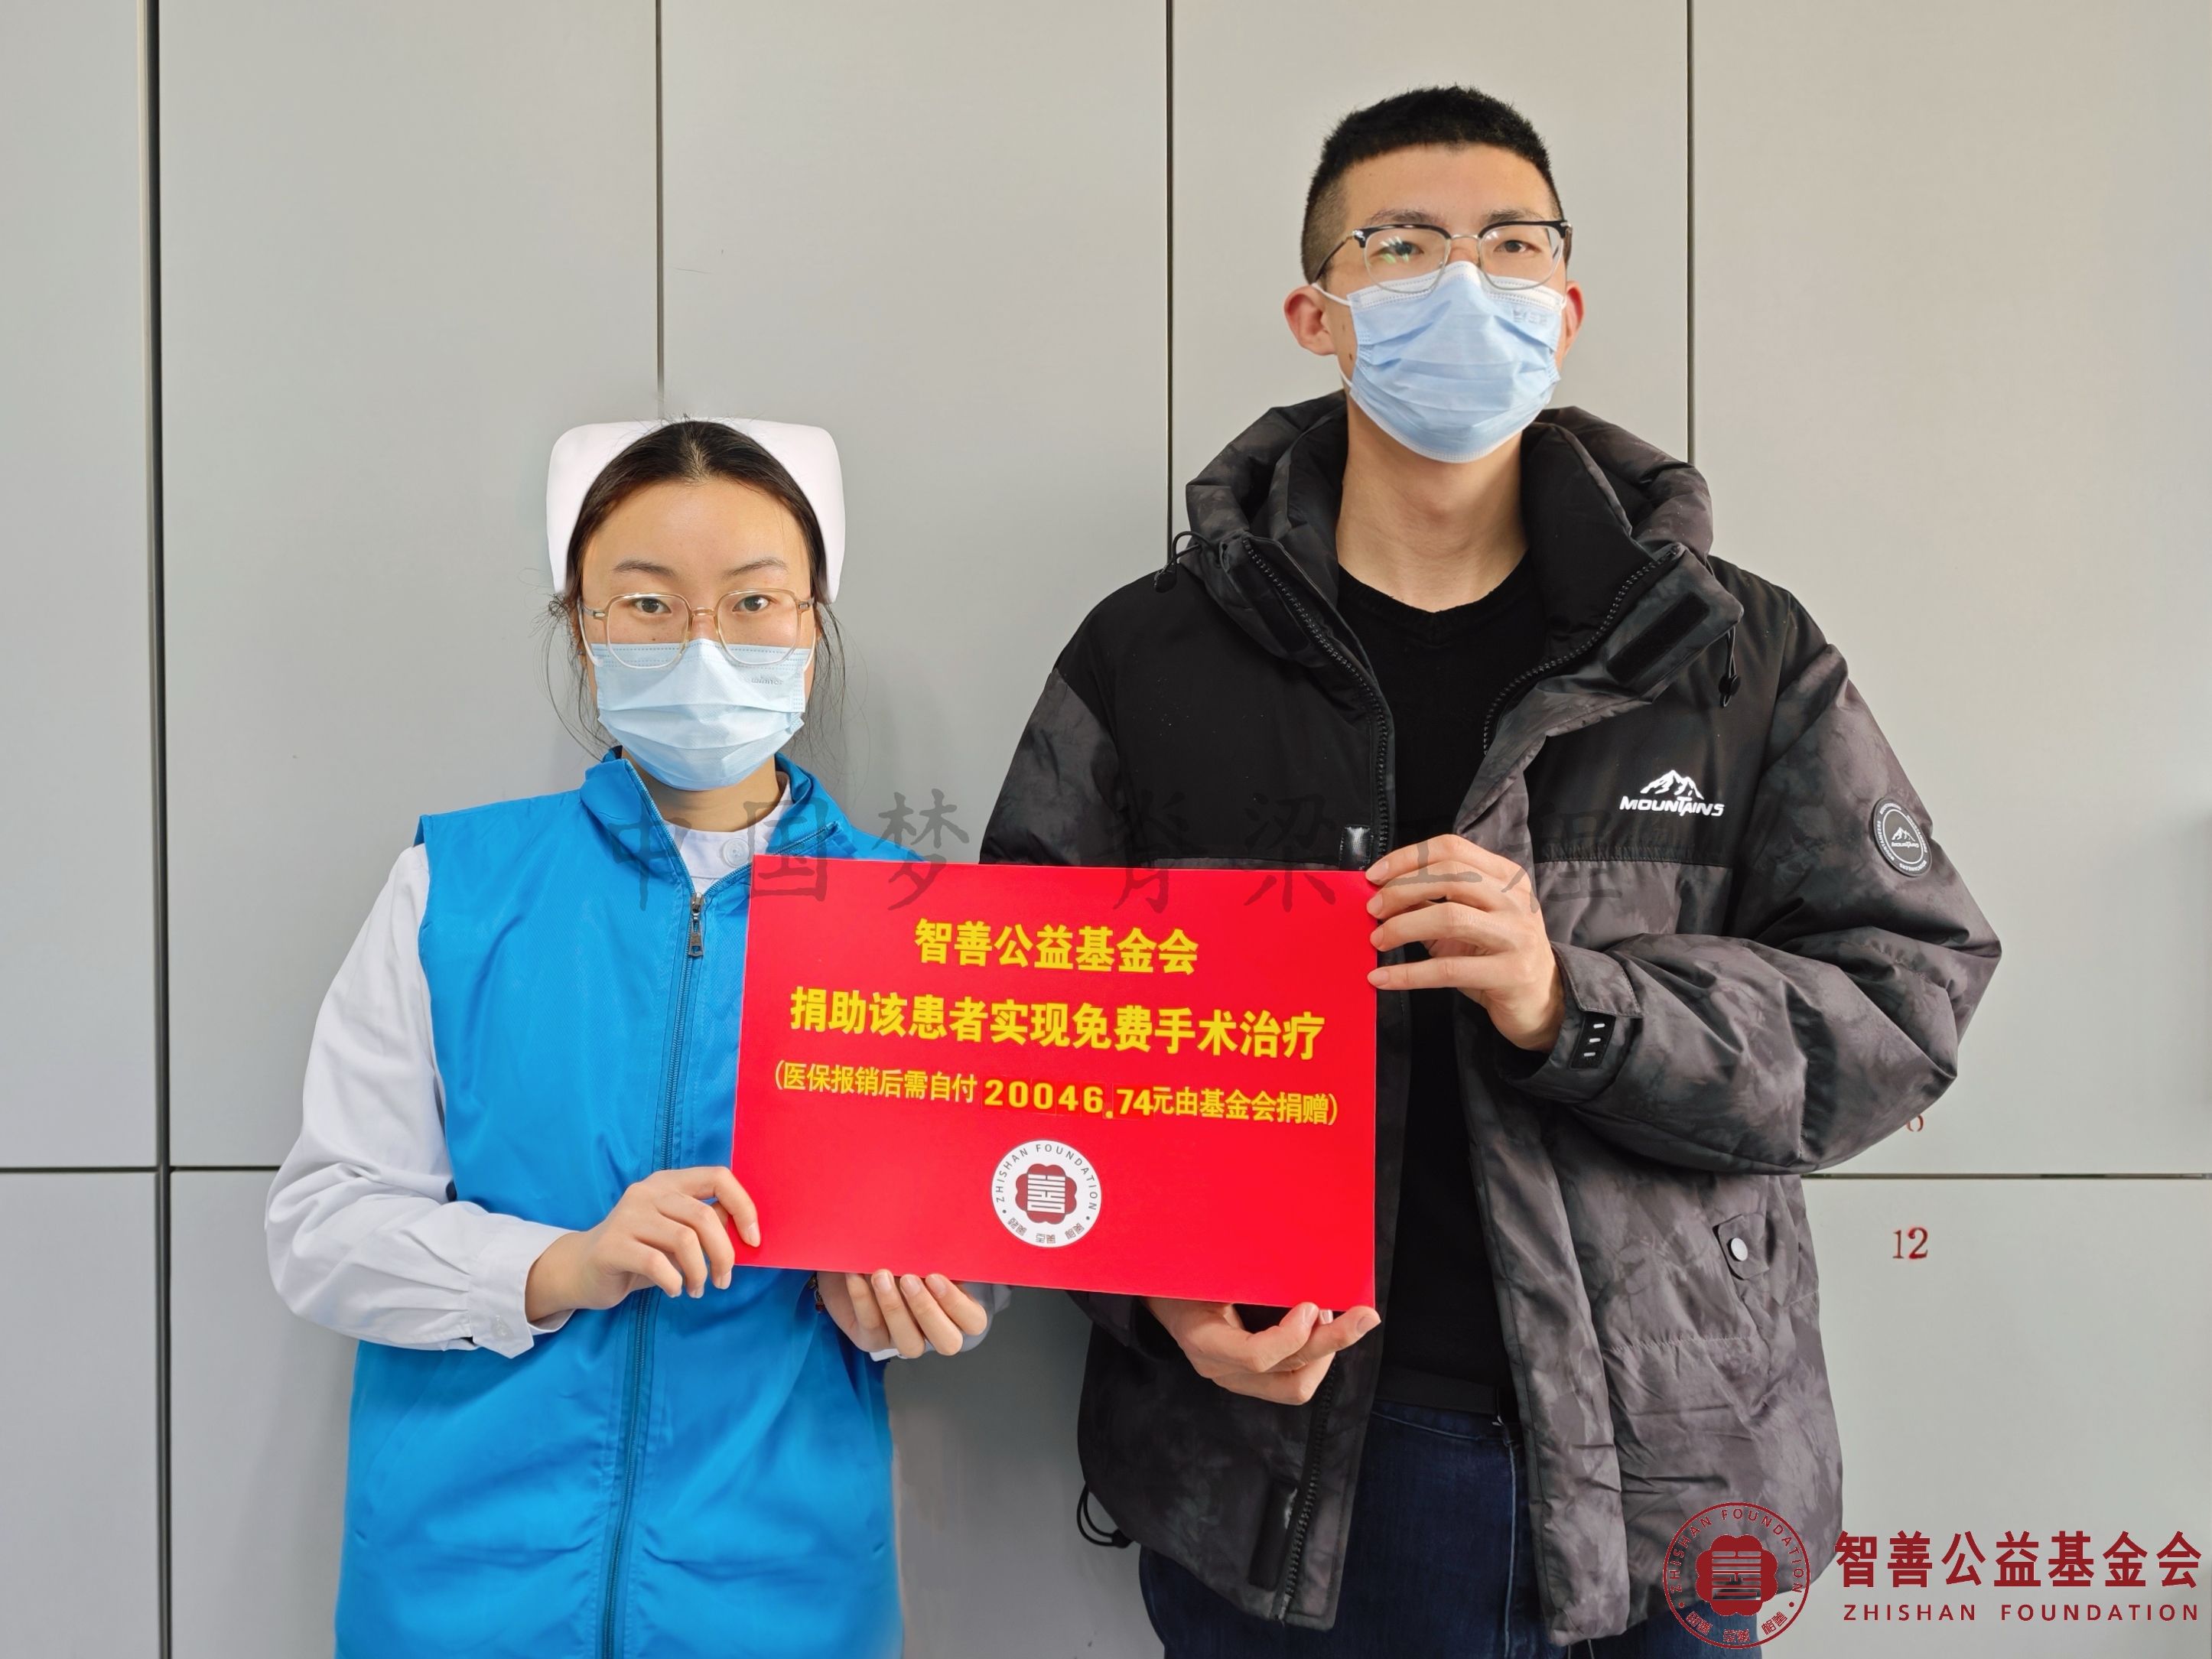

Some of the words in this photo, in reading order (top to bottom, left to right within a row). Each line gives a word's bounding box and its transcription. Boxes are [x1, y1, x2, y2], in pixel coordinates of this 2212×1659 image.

[1619, 795, 1726, 817] MOUNTAINS
[915, 918, 1199, 976] 智善公益基金会
[790, 985, 1326, 1061] 捐助该患者实现免费手术治疗
[996, 1148, 1029, 1203] ZHISHAN
[1036, 1143, 1098, 1210] FOUNDATION
[1892, 1227, 1928, 1260] 12
